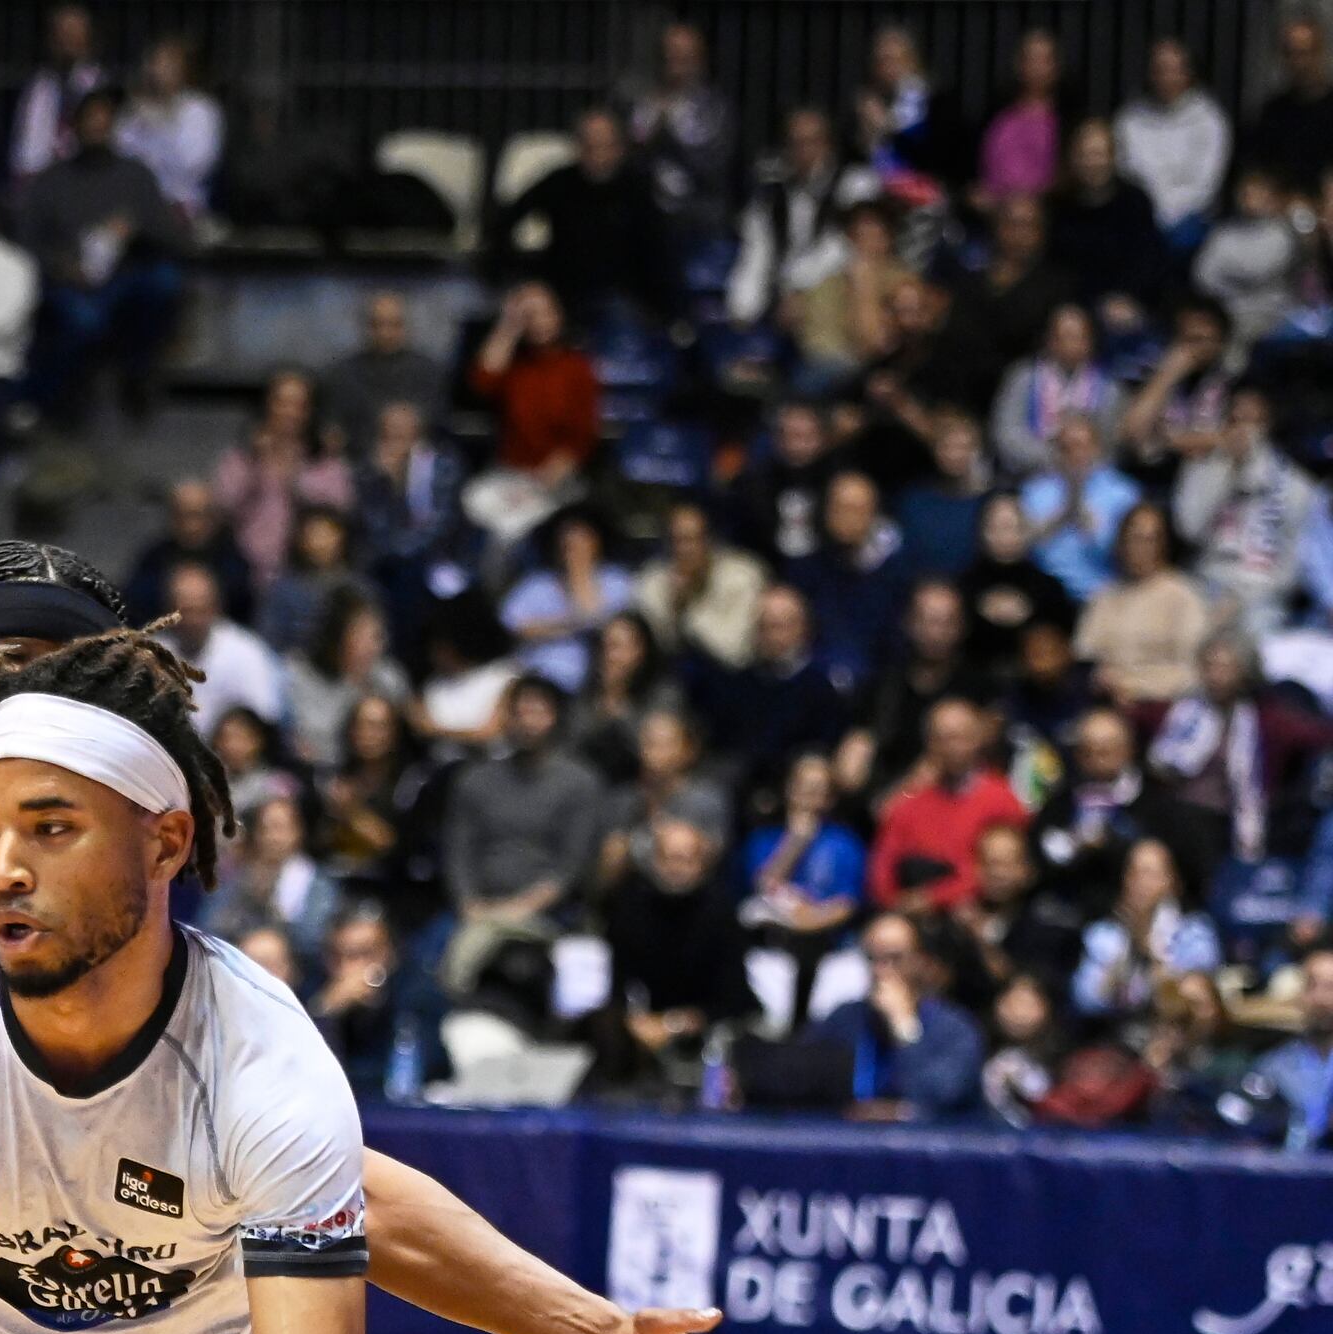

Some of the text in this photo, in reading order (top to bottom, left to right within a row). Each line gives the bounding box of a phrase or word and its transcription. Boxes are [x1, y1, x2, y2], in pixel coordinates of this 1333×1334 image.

[120, 1188, 180, 1215] endesa
[121, 1171, 148, 1192] liga
[734, 1188, 970, 1268] XUNTA
[726, 1257, 819, 1327] DE
